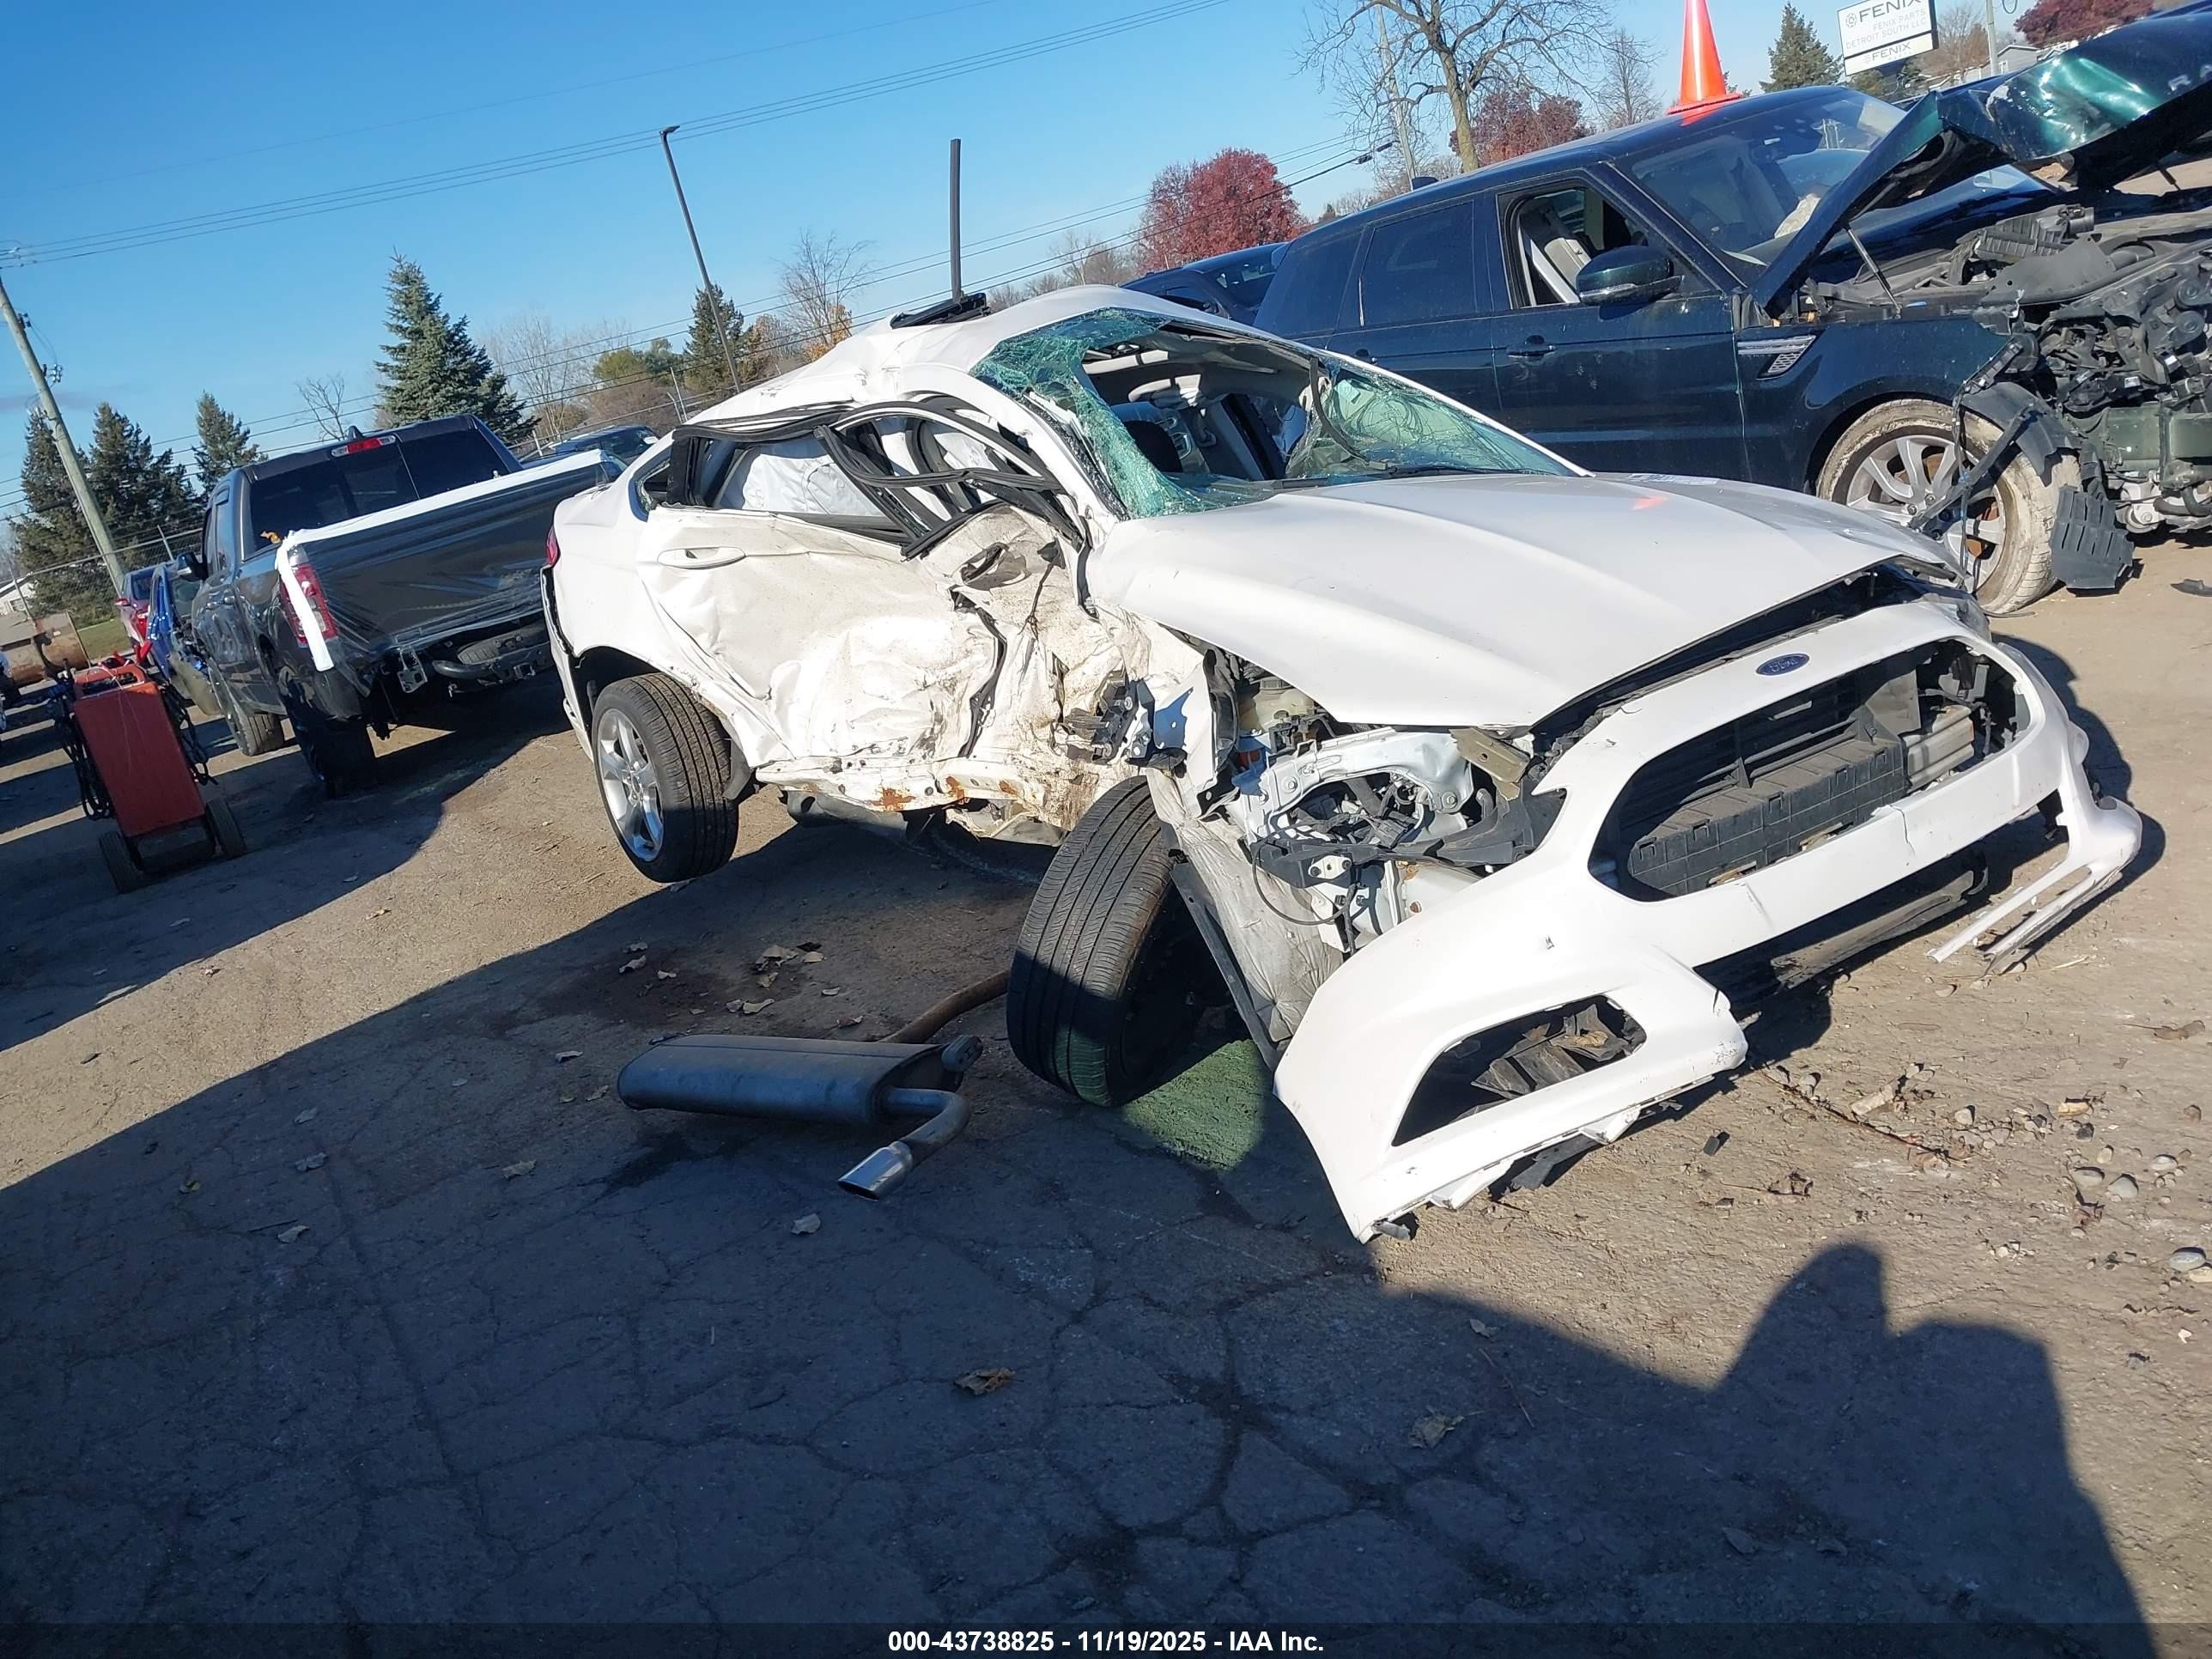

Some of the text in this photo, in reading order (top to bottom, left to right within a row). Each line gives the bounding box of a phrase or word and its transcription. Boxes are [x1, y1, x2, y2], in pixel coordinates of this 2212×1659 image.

[1873, 9, 1926, 30] FENIX PARTS
[1846, 17, 1926, 49] DETROIT SOUTH LLC
[1872, 41, 1911, 61] FENIX
